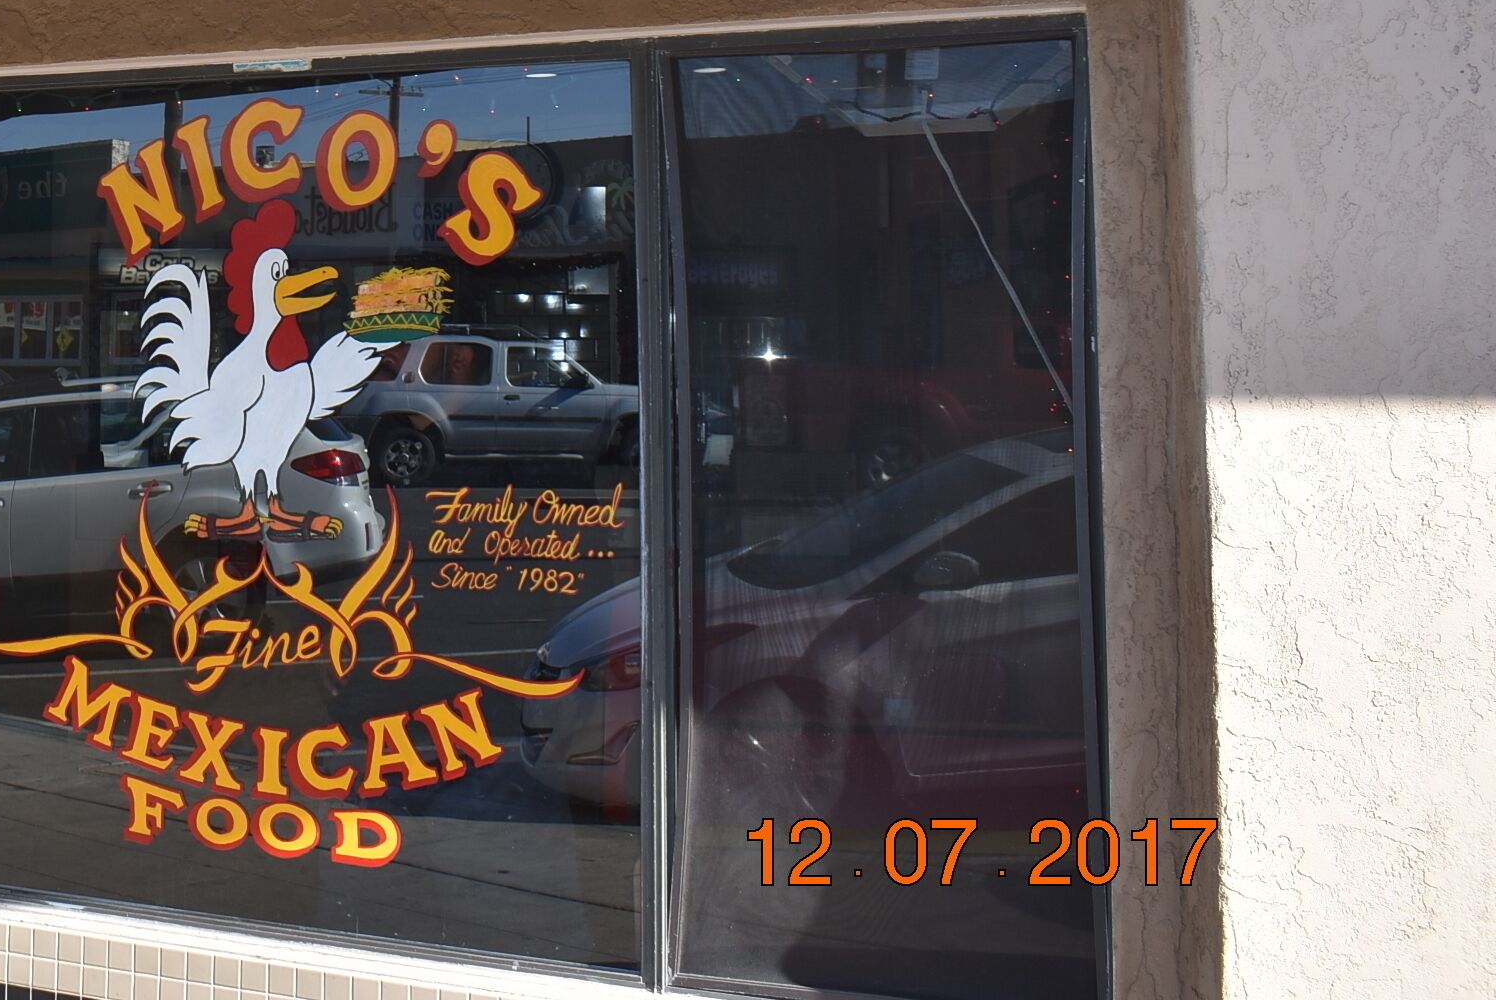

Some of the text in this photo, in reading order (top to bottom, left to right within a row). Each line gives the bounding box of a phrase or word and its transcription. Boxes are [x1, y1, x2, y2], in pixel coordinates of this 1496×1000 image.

[98, 97, 543, 265] NICO'S
[425, 481, 626, 537] Family Owned
[431, 562, 499, 590] Since
[186, 618, 324, 694] Fine
[42, 654, 505, 799] MEXICAN
[119, 772, 402, 868] FOOD
